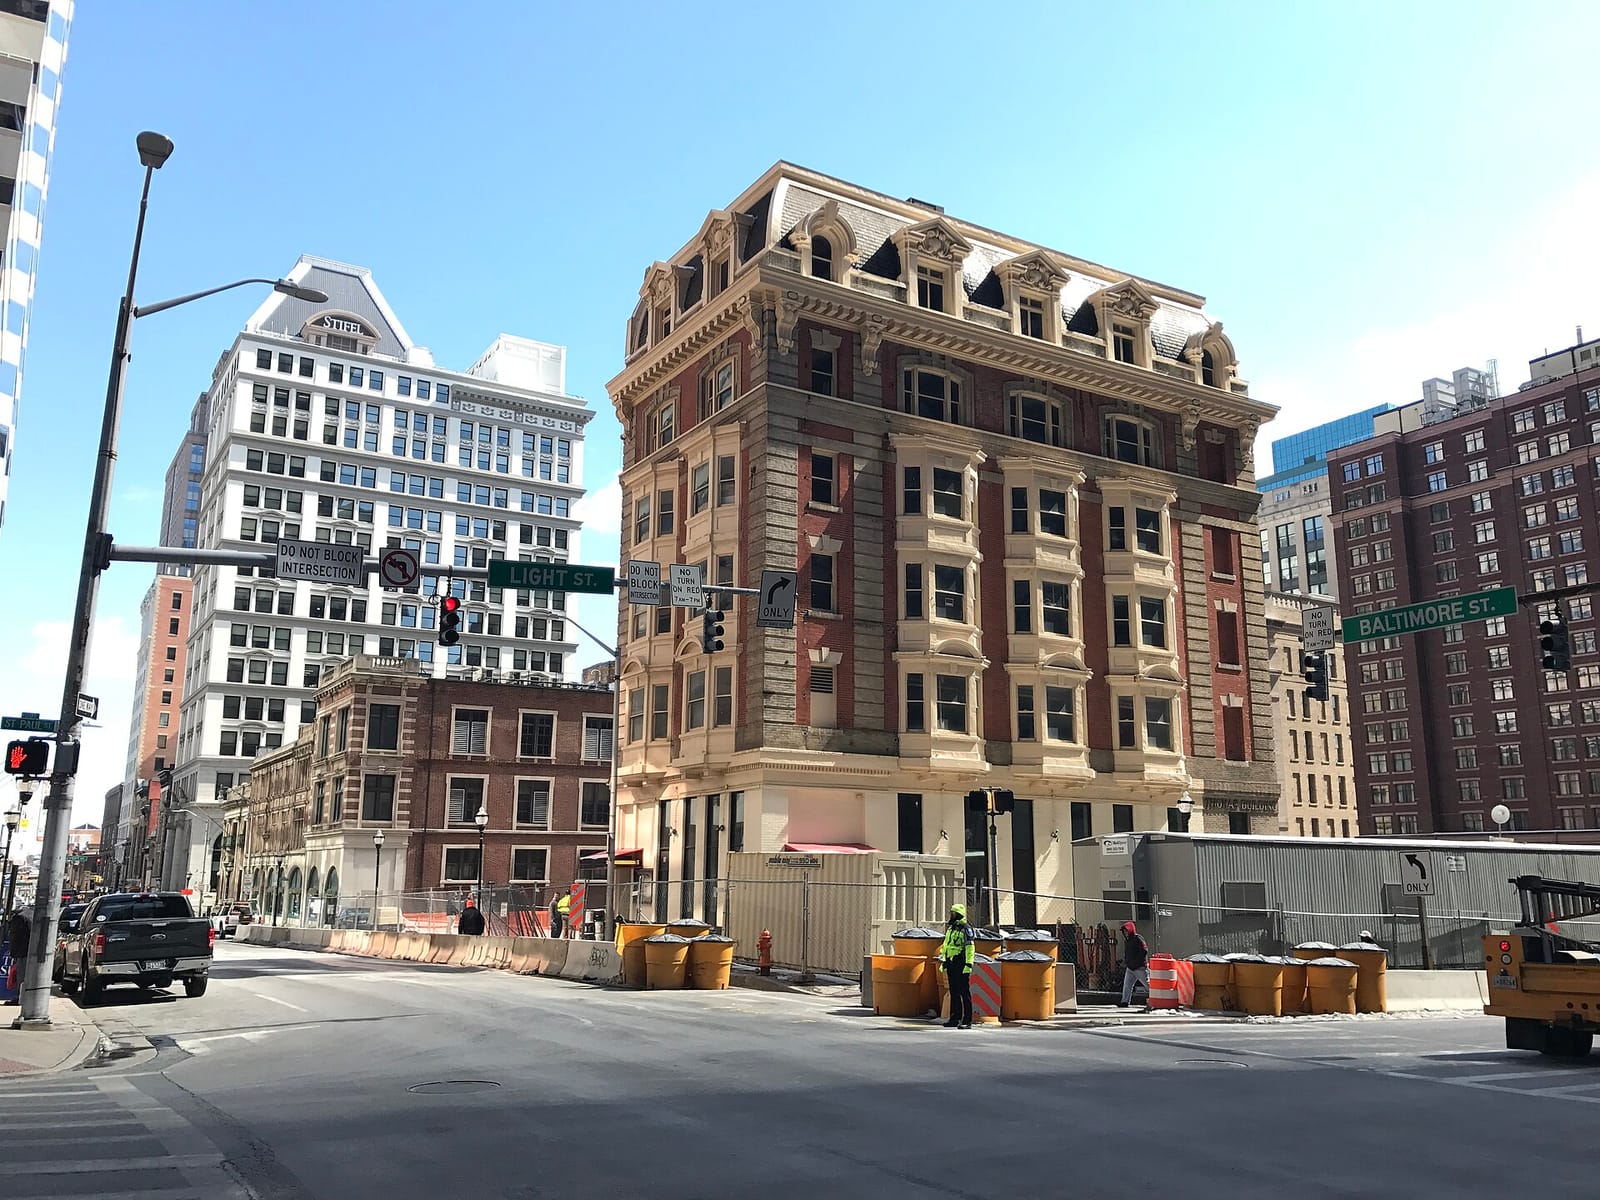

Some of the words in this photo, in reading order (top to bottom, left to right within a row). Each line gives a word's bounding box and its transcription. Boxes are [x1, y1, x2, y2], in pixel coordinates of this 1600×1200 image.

[323, 315, 364, 335] STIFEL
[281, 545, 296, 557] DO
[300, 547, 320, 560] NOT
[324, 549, 359, 563] BLOCK
[282, 561, 356, 580] INTERSECTION
[630, 565, 641, 575] DO
[644, 567, 659, 577] NOT
[679, 568, 691, 576] NO
[510, 566, 568, 587] LIGHT
[573, 572, 598, 587] ST.
[677, 577, 695, 585] TURN
[631, 579, 659, 590] BLOCK
[672, 585, 683, 593] ON
[686, 586, 700, 594] RED
[630, 591, 659, 600] INTERSECTION
[763, 607, 790, 618] ONLY
[1311, 611, 1323, 620] NO
[1359, 601, 1465, 636] BALTIMORE
[1468, 597, 1496, 615] ST.
[1309, 620, 1327, 629] TURN
[1304, 631, 1314, 639] ON
[1317, 628, 1332, 637] RED
[19, 719, 42, 730] PAUL
[1241, 801, 1278, 812] BUILDING
[1406, 883, 1430, 892] ONLY
